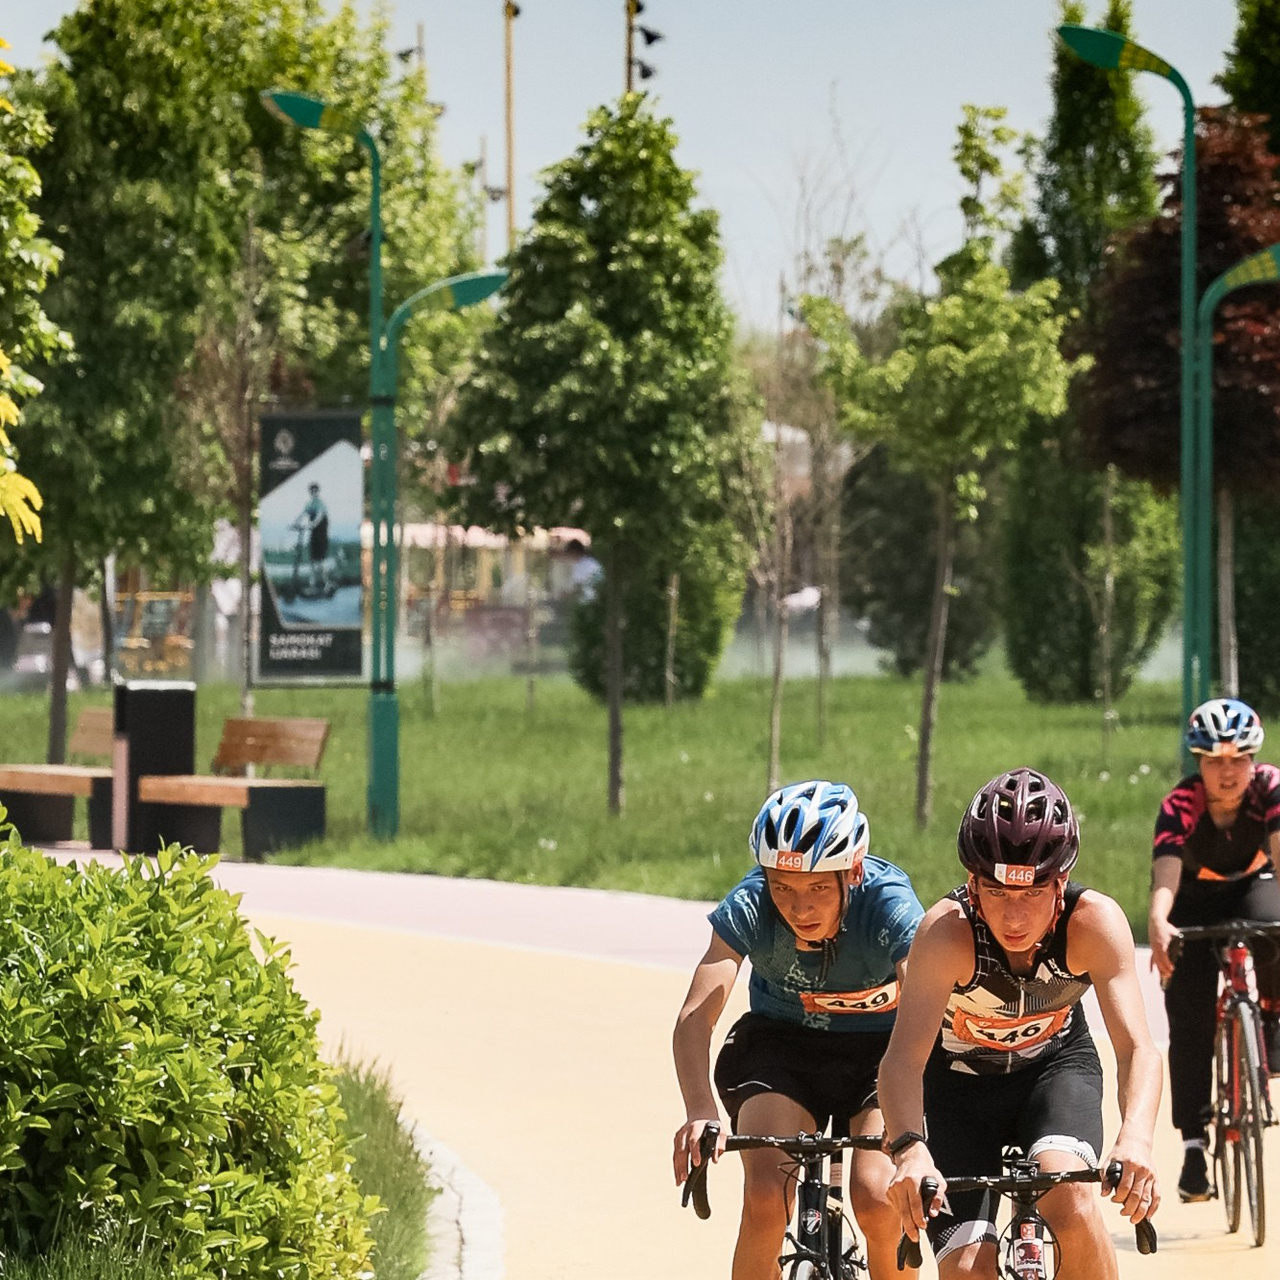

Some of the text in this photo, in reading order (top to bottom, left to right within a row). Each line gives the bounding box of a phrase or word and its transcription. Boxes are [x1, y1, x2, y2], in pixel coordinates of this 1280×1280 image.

[778, 856, 801, 868] 449
[1008, 869, 1033, 882] 446
[827, 992, 889, 1009] 449
[976, 1023, 1041, 1043] 446
